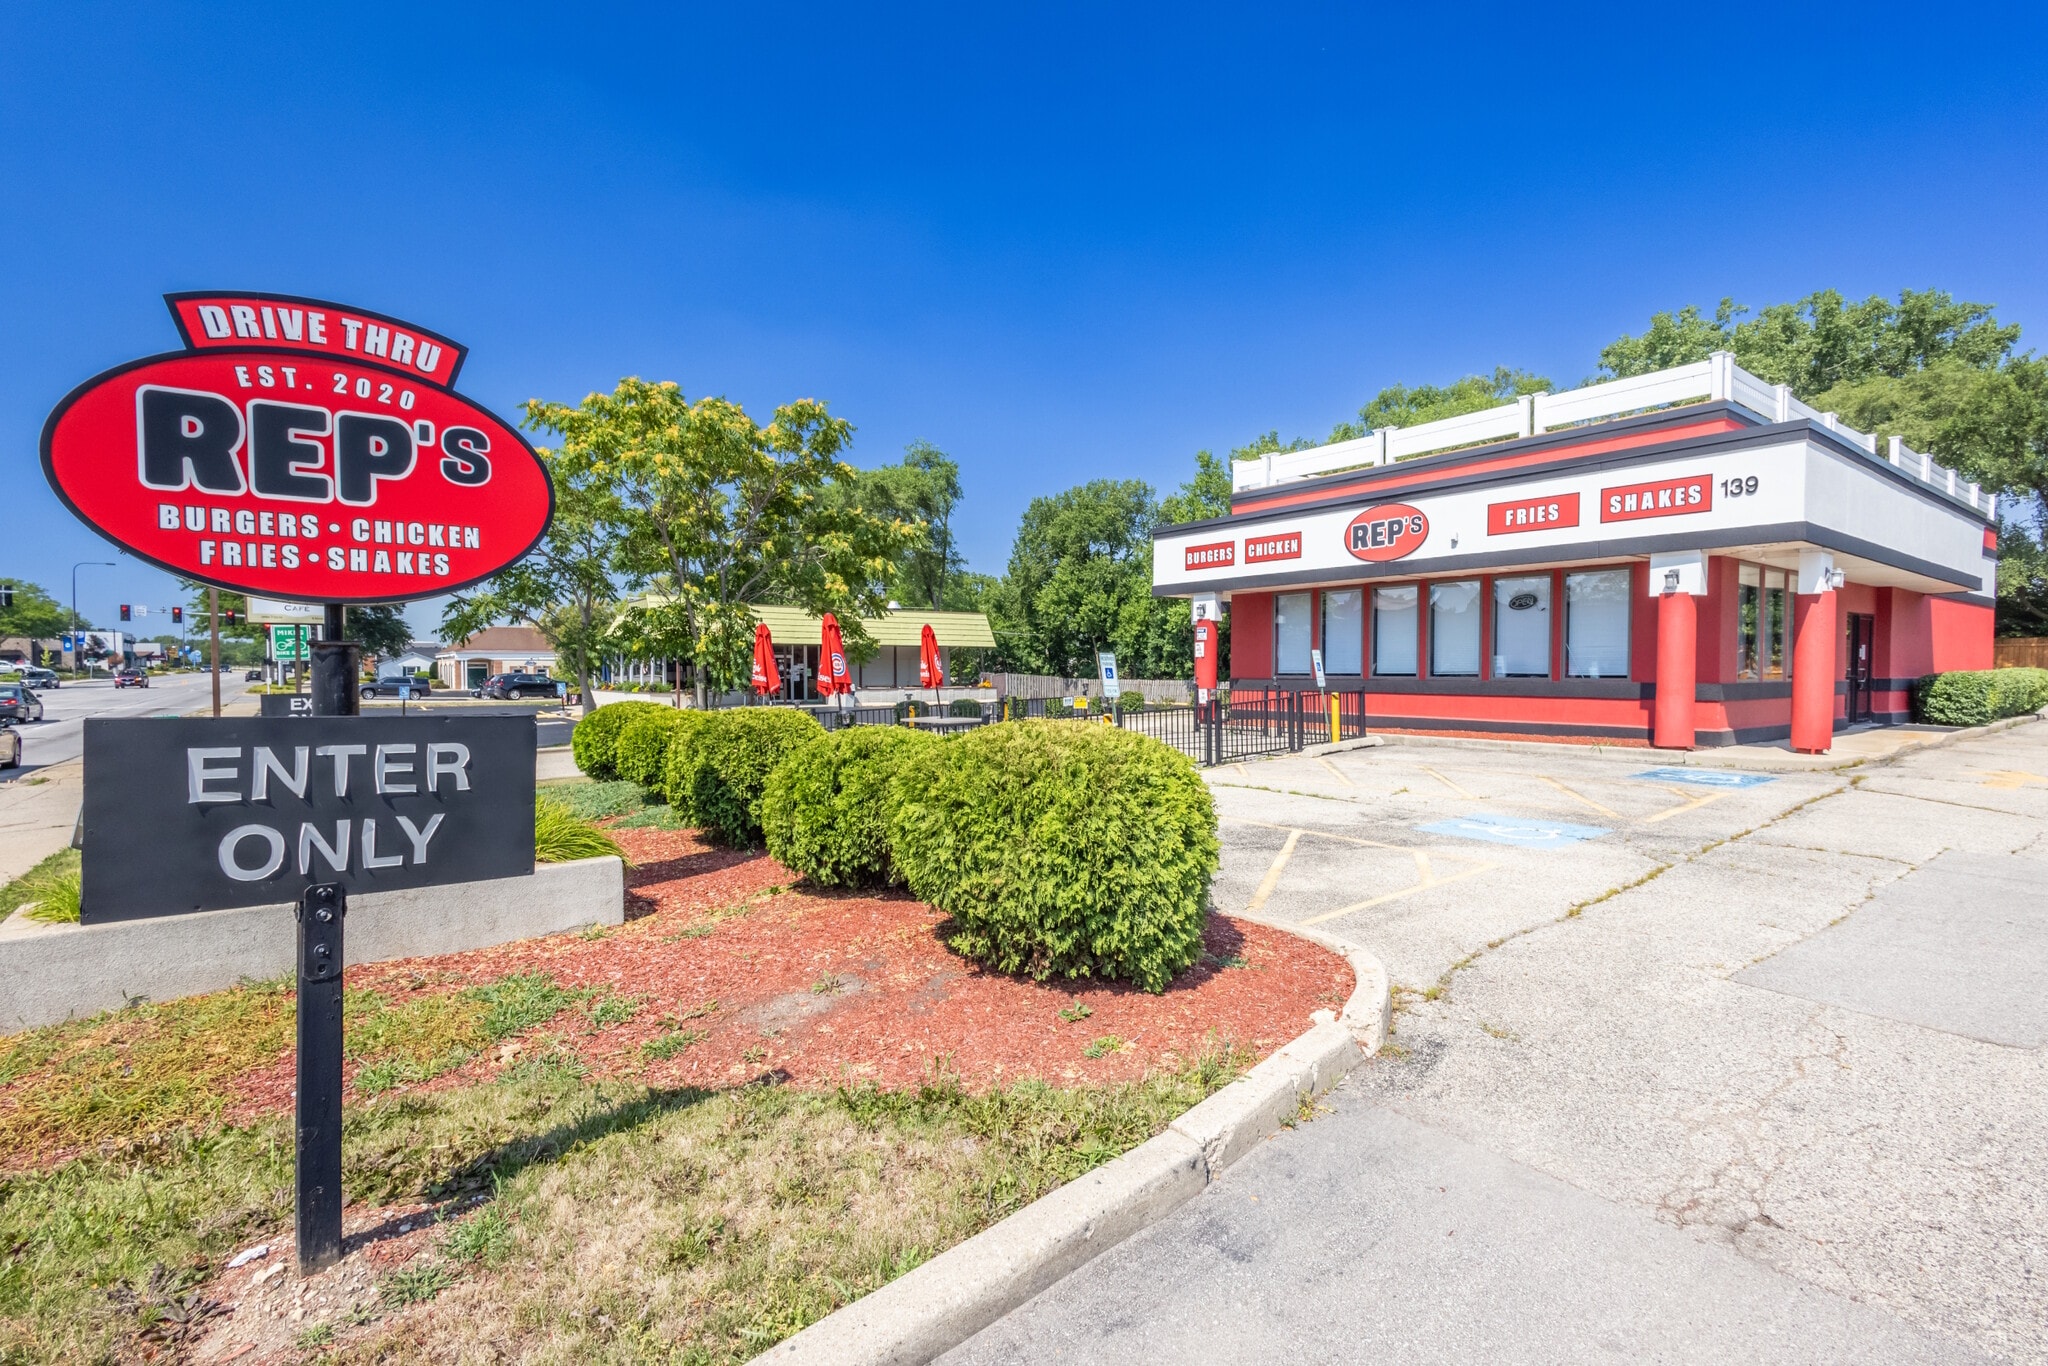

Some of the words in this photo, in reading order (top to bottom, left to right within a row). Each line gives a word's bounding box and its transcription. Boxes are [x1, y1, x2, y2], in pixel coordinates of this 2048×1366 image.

[198, 305, 327, 344] DRIVE
[341, 318, 442, 373] THRU
[234, 366, 312, 390] EST.
[333, 373, 416, 411] 2020
[136, 383, 492, 507] REP'S
[1610, 484, 1702, 514] SHAKES
[1720, 475, 1759, 498] 139
[158, 504, 319, 538] BURGERS
[352, 518, 481, 549] CHICKEN
[1351, 514, 1424, 551] REP'S
[1505, 504, 1559, 527] FRIES
[200, 540, 301, 569] FRIES
[327, 547, 450, 576] SHAKES
[1186, 547, 1233, 565] BURGERS
[1248, 538, 1299, 557] CHICKEN
[187, 743, 471, 804] ENTER
[218, 813, 446, 881] ONLY
